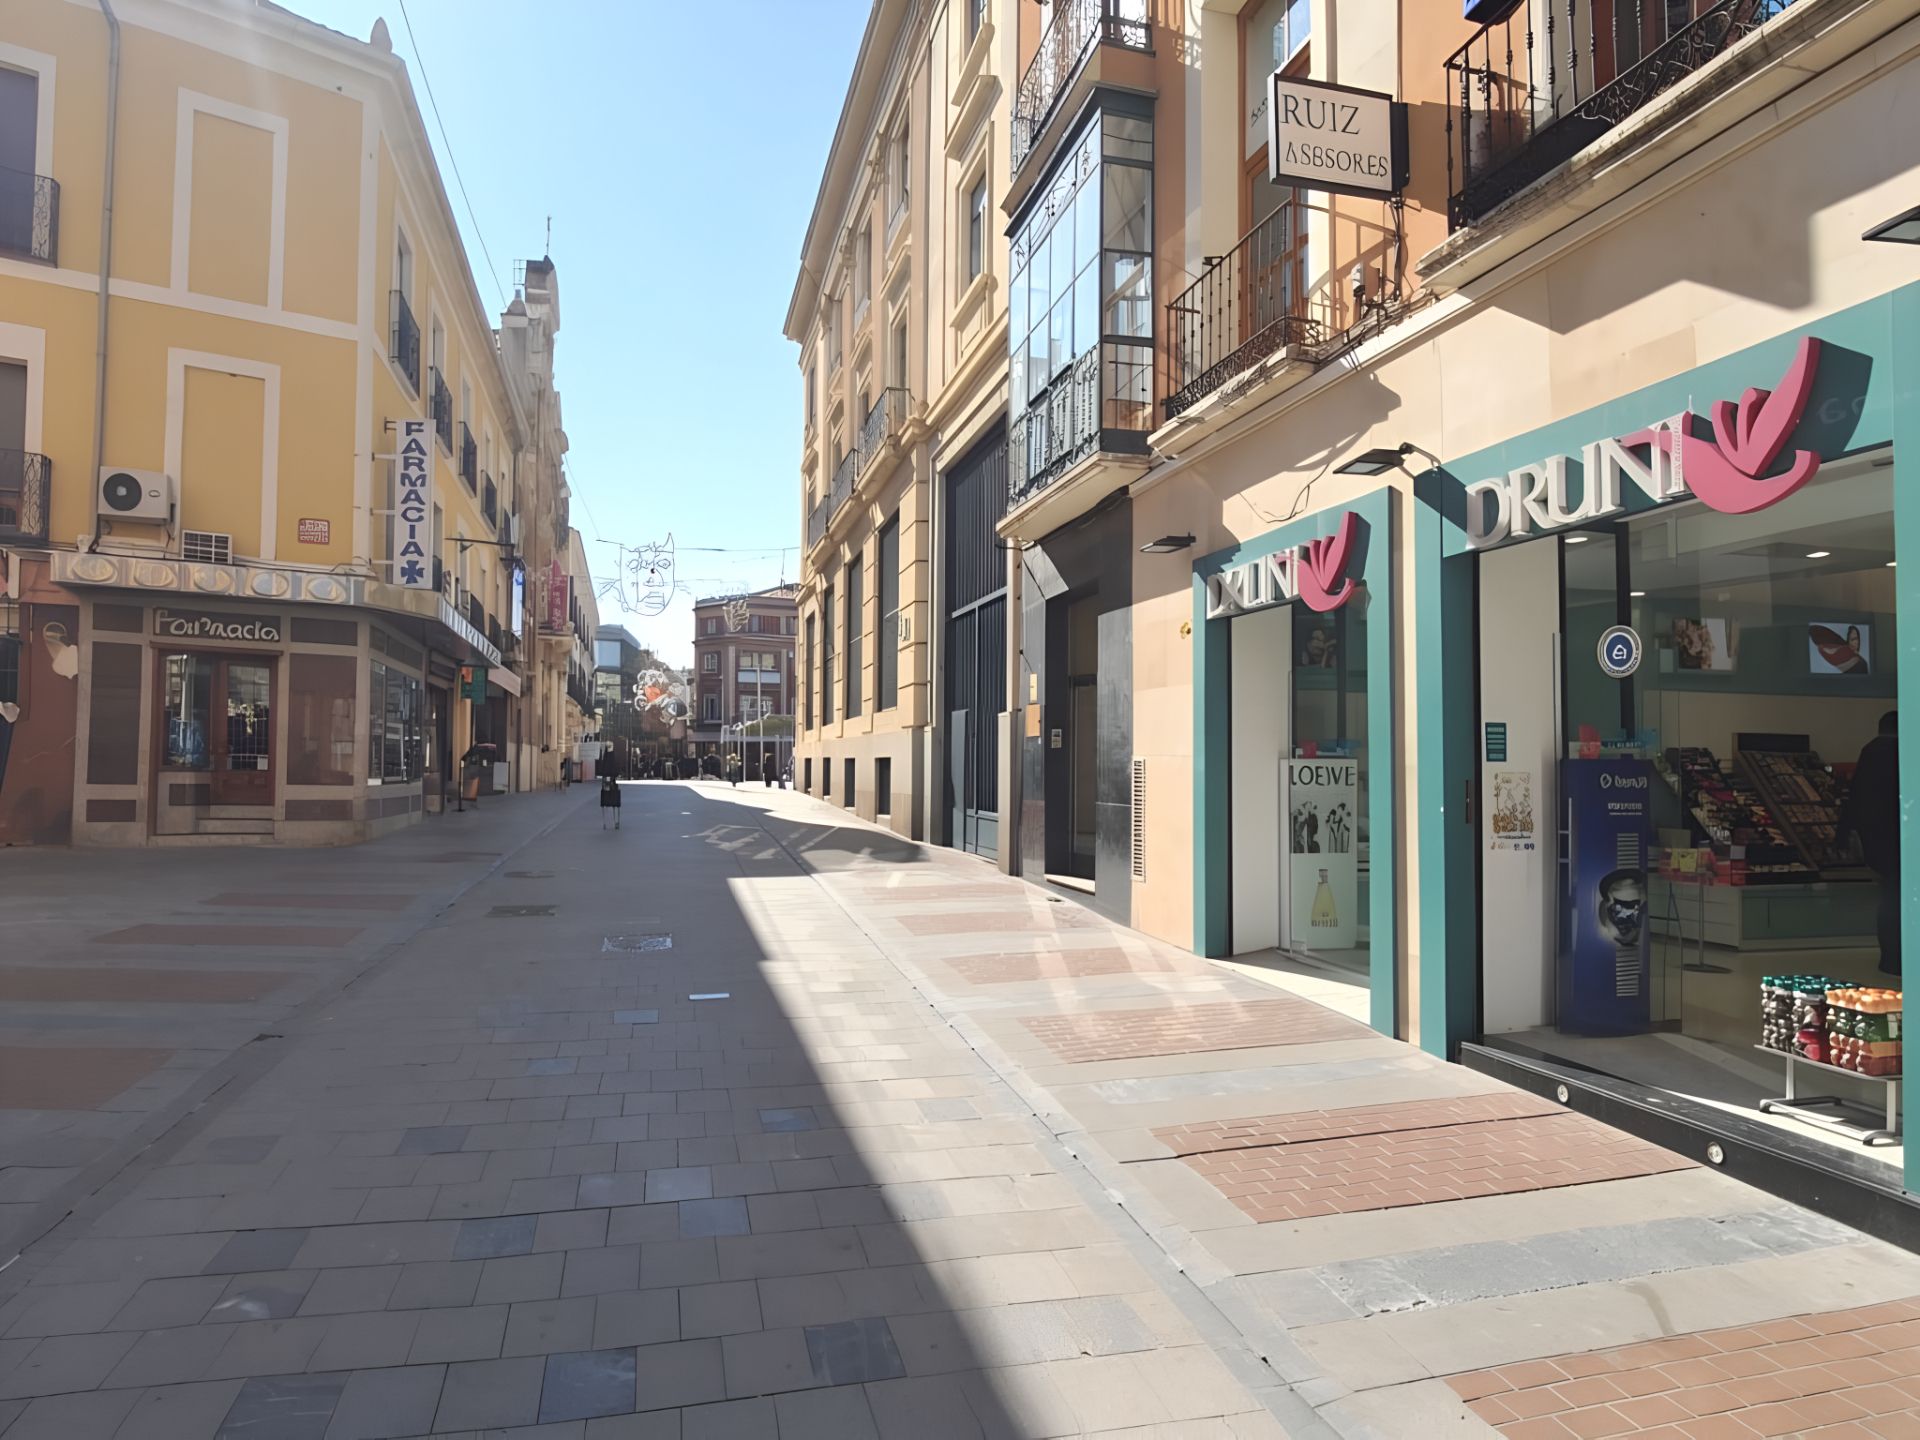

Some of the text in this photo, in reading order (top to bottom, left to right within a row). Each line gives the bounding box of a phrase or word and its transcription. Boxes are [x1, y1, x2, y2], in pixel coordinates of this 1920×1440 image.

[1280, 93, 1361, 134] RUIZ
[400, 421, 427, 557] FARMACIA
[1466, 411, 1690, 549] DRUNI
